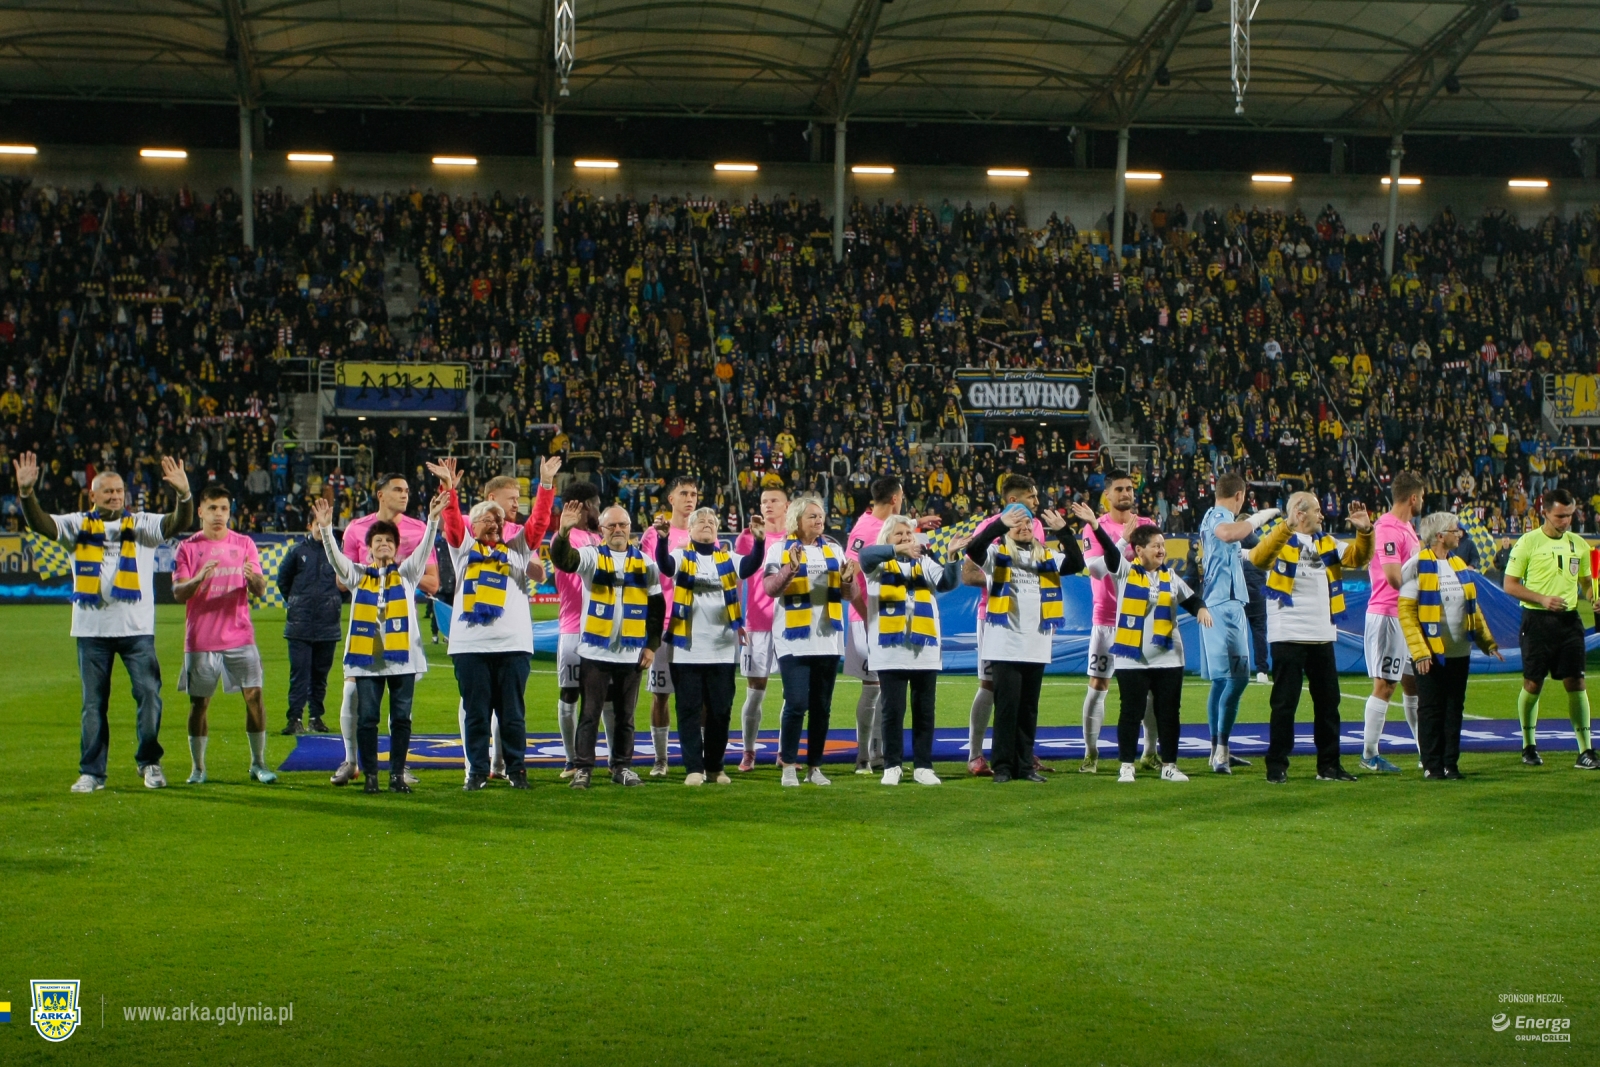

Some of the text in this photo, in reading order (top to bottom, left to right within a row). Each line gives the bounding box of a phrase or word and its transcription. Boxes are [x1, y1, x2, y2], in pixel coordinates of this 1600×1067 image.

[1004, 371, 1045, 381] Fan Club
[355, 370, 449, 402] ARKA
[968, 381, 1081, 409] GNIEWINO
[744, 654, 752, 671] 11
[1089, 654, 1108, 673] 23
[1231, 656, 1248, 673] 77
[1381, 656, 1401, 675] 29
[567, 664, 580, 682] 10
[651, 670, 666, 687] 35
